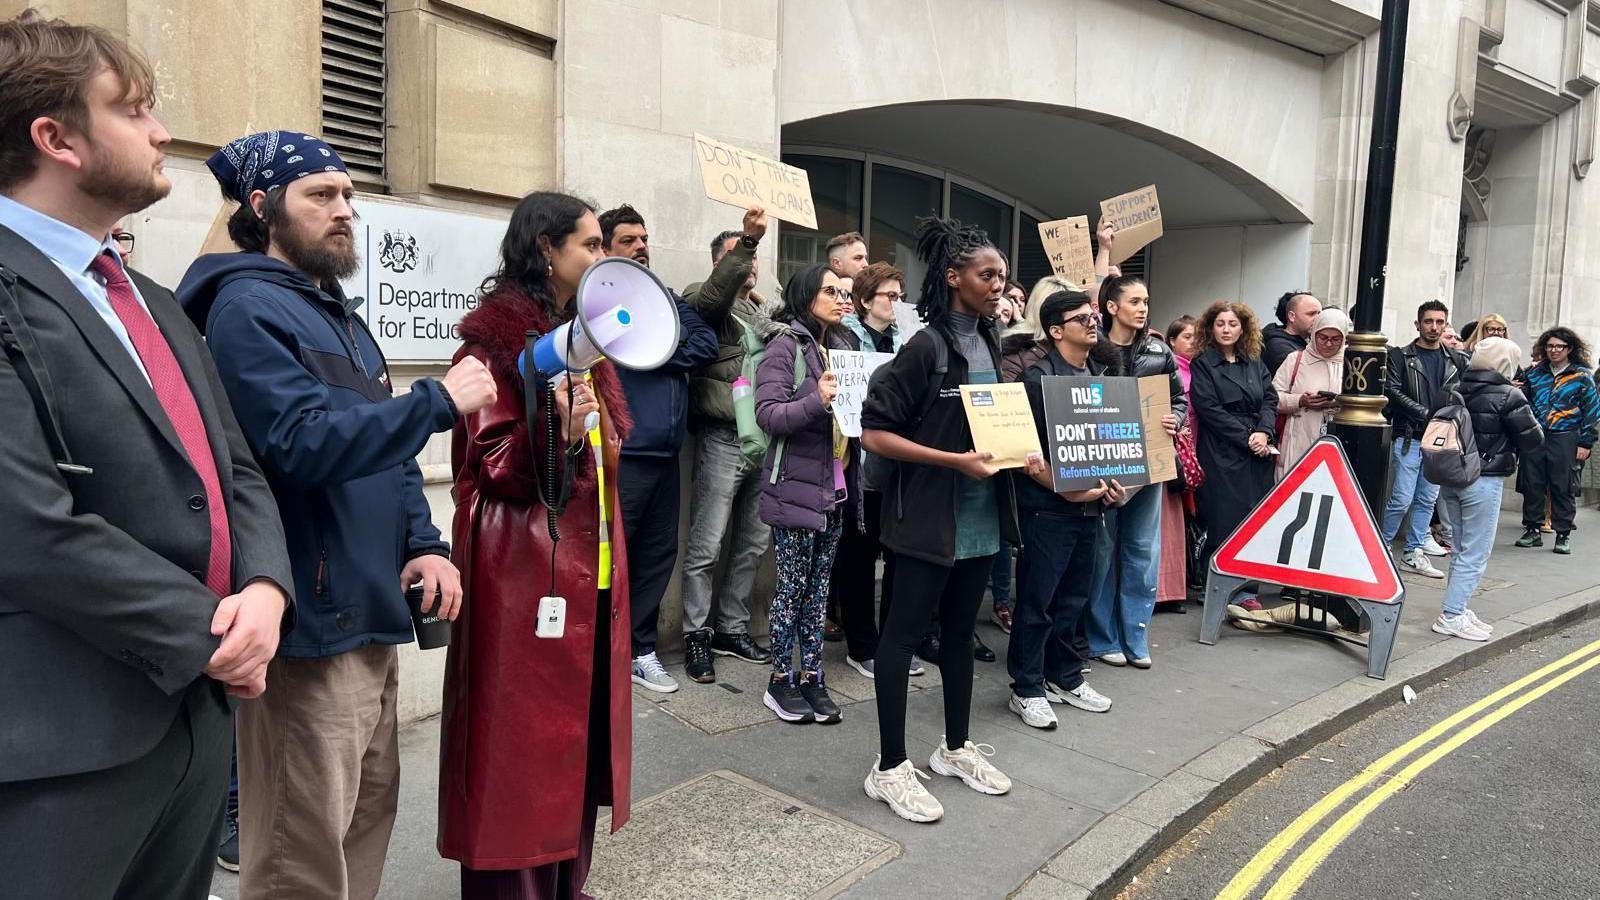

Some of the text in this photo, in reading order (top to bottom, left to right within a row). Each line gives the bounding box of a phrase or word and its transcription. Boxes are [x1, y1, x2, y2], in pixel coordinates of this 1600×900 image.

[722, 173, 812, 216] OUR LOANS
[1106, 191, 1153, 216] SUPPORT
[1045, 227, 1060, 239] WE
[379, 282, 481, 312] Departme
[378, 315, 406, 338] for
[832, 355, 865, 369] NO TO
[831, 393, 852, 407] OR
[1071, 387, 1102, 405] nus
[1055, 423, 1097, 441] DON'T
[1097, 422, 1140, 440] FREEZE
[1057, 442, 1143, 463] OUR FUTURES
[1060, 464, 1145, 479] Reform Student Loans
